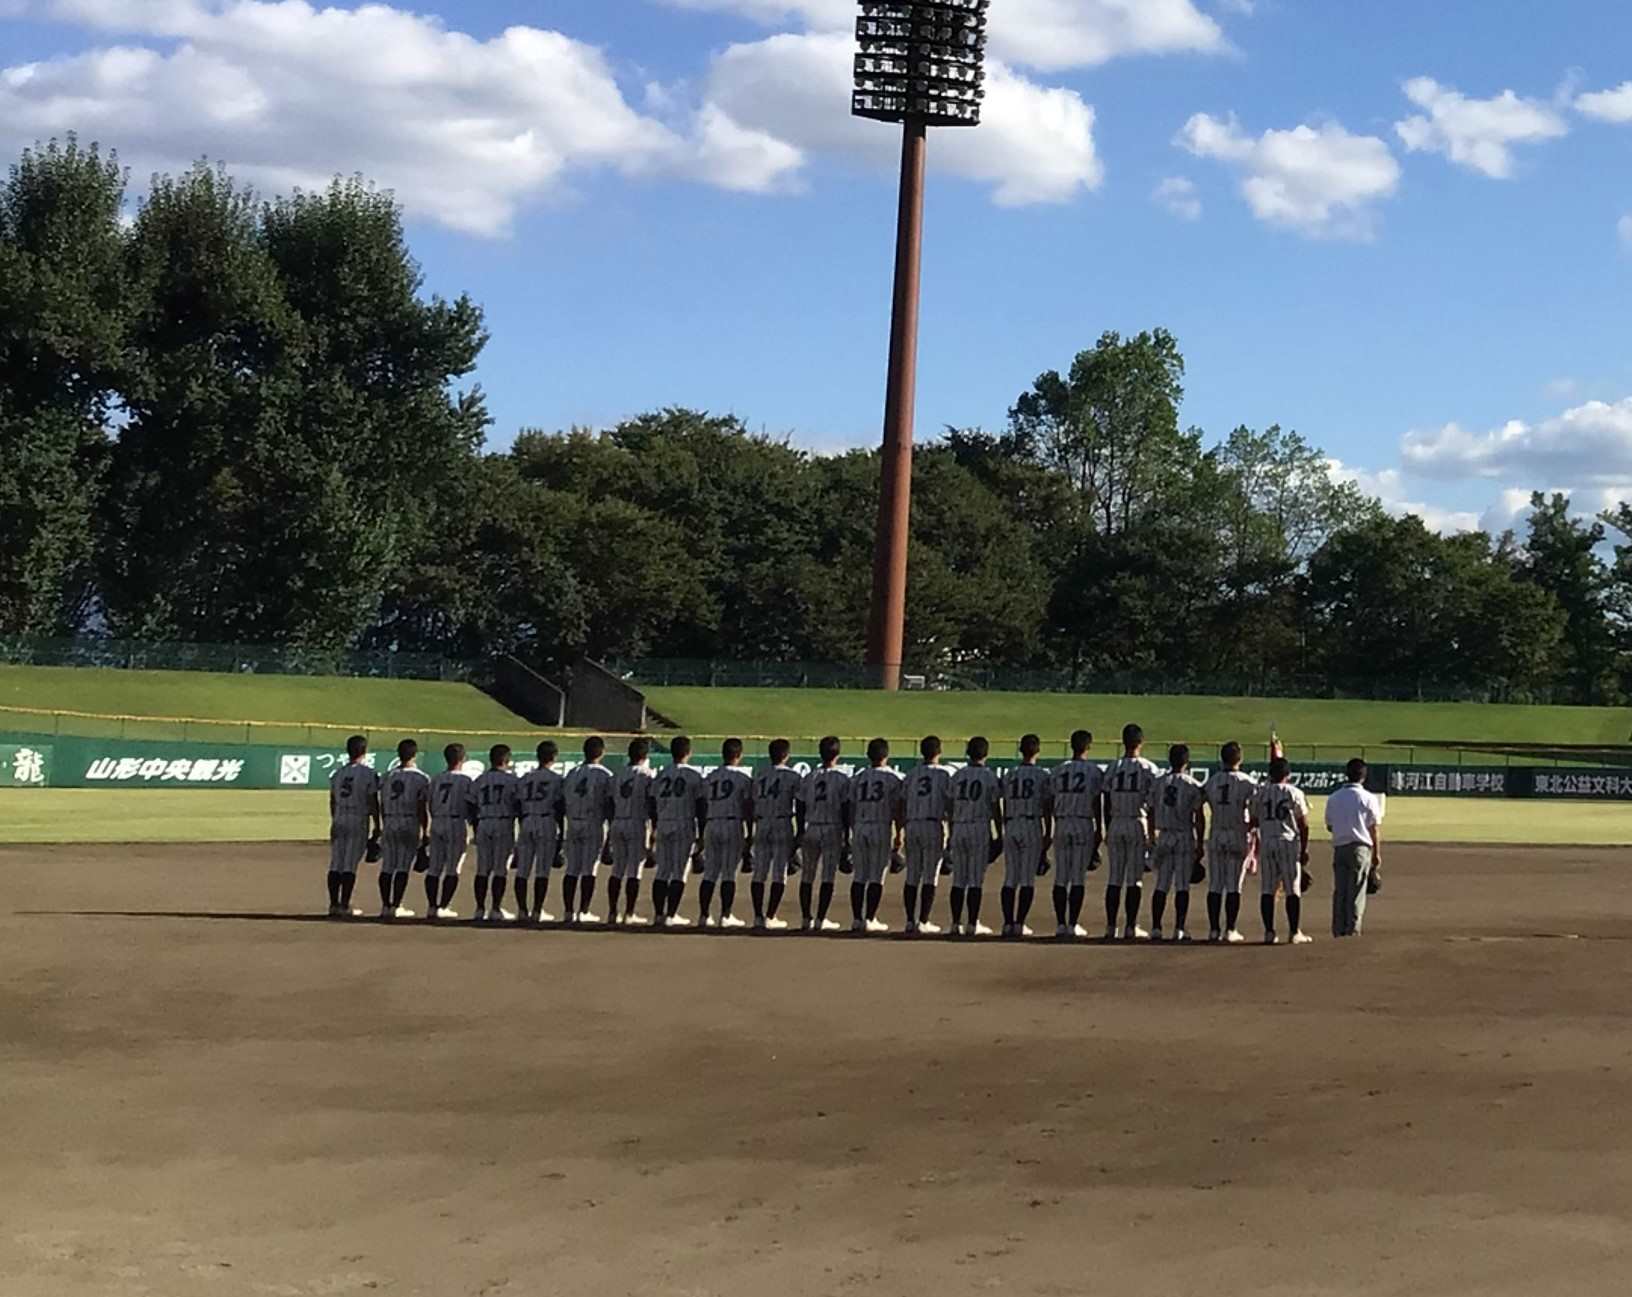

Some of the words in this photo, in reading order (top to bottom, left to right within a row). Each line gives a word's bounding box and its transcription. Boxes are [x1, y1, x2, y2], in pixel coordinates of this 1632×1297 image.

[86, 757, 245, 781] 山形中央観光
[525, 781, 550, 801] 15
[573, 777, 588, 798] 4
[660, 777, 686, 798] 20
[711, 779, 734, 800] 19
[758, 778, 780, 799] 14
[815, 780, 828, 801] 2
[860, 781, 884, 801] 13
[917, 775, 932, 796] 3
[958, 779, 982, 801] 10
[1010, 777, 1034, 799] 18
[1060, 772, 1085, 793] 12
[1115, 771, 1139, 793] 11
[439, 783, 453, 804] 7
[481, 784, 502, 805] 17
[1264, 800, 1289, 821] 16
